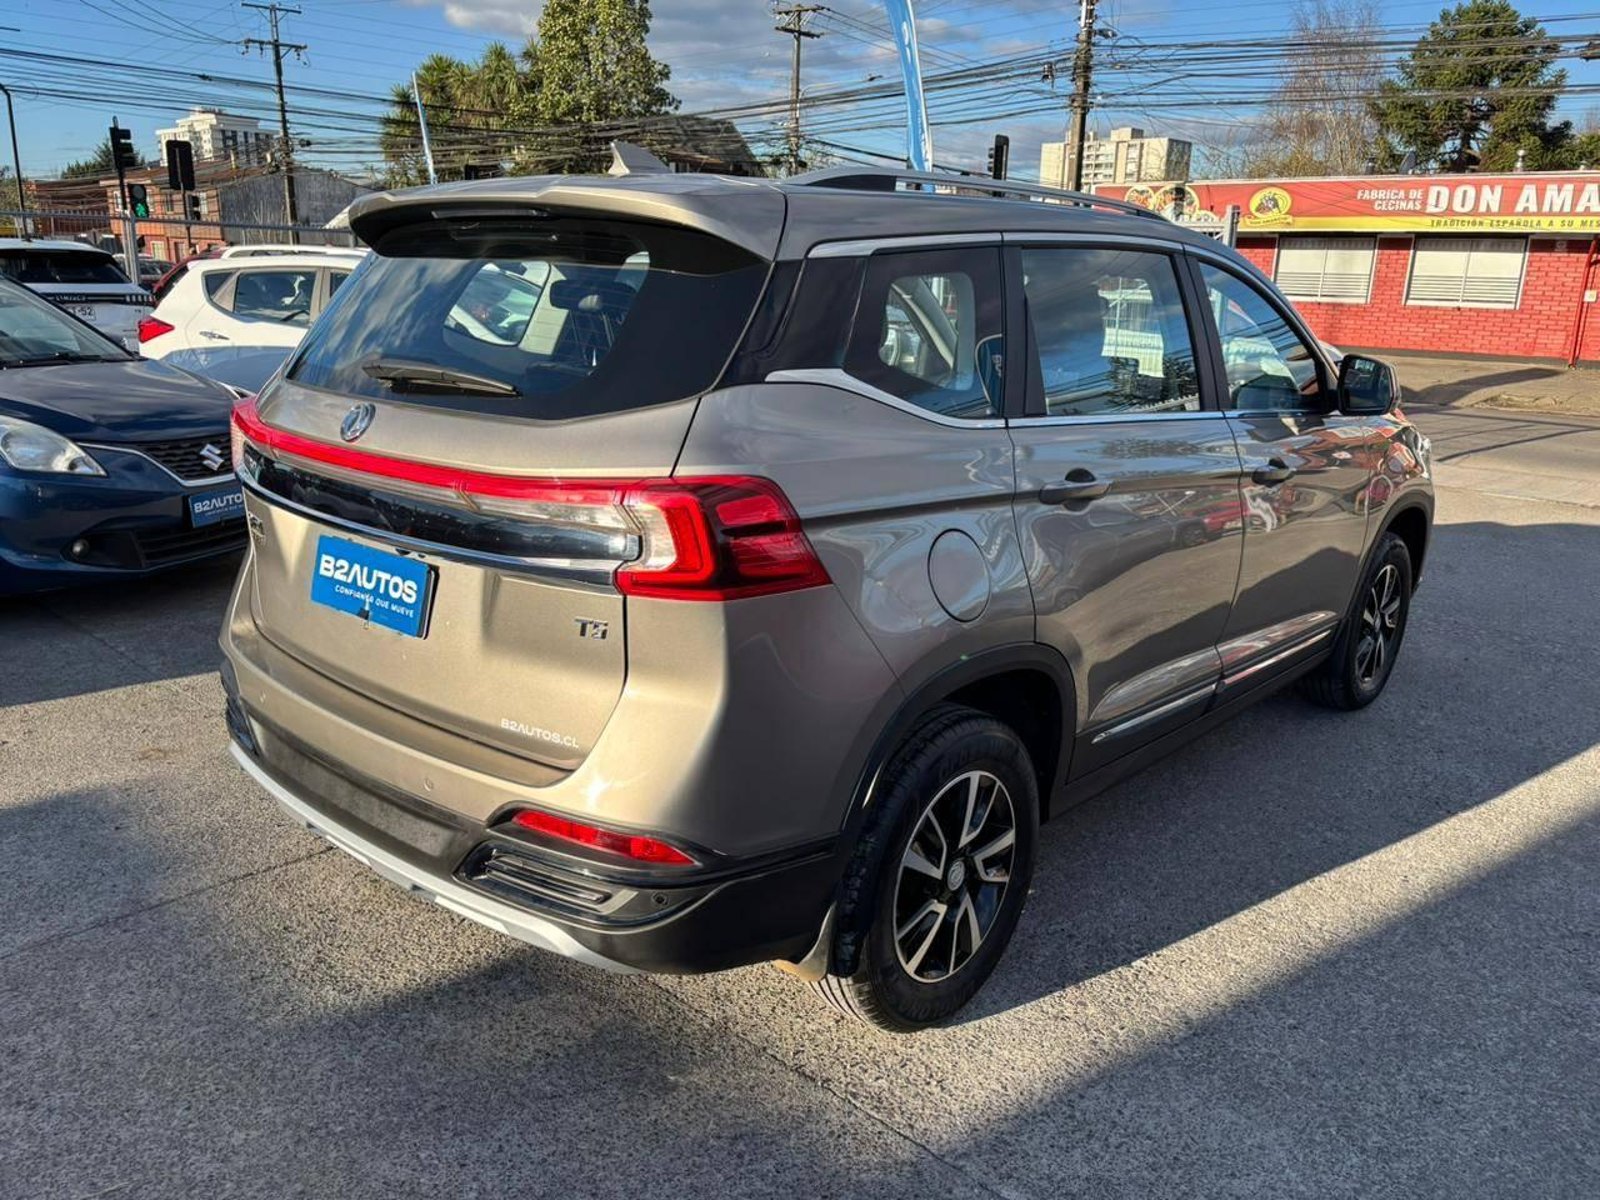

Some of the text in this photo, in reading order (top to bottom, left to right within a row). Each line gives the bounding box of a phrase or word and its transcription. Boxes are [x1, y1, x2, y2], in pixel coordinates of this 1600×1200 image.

[1409, 188, 1423, 199] DE
[1425, 182, 1600, 214] DON AMA
[1374, 199, 1421, 211] CECINAS
[1548, 219, 1554, 227] A
[1560, 218, 1574, 228] SU
[318, 553, 418, 605] B2AUTOS
[375, 598, 390, 610] QUE
[390, 604, 414, 619] MUEVE
[500, 718, 580, 749] B2AUTOS.CL
